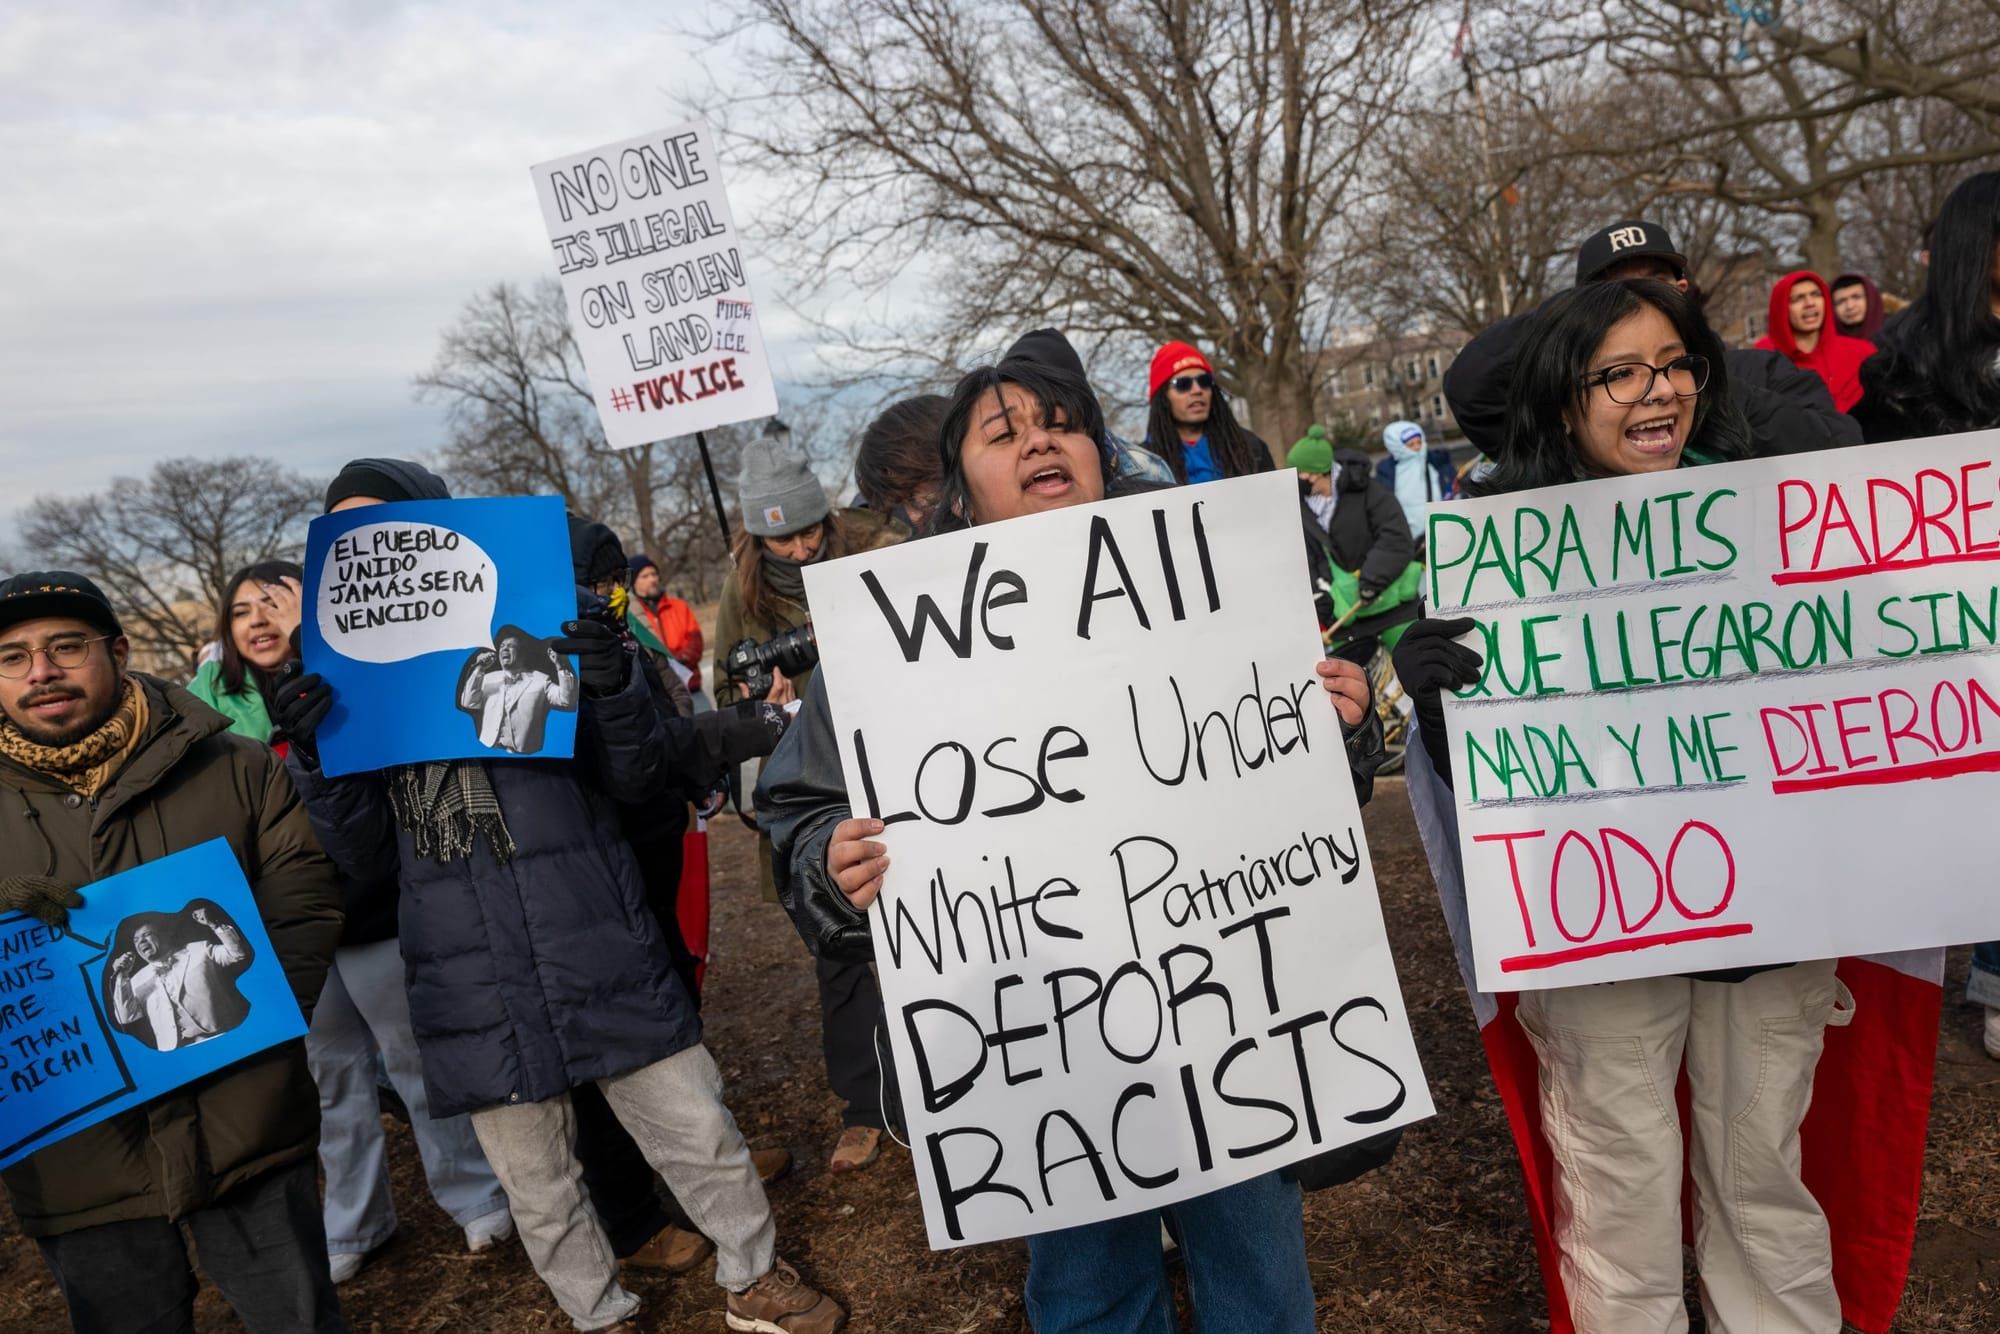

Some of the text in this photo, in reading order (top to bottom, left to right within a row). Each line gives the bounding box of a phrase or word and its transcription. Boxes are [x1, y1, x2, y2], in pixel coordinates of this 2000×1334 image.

[551, 132, 709, 222] NO ONE
[552, 200, 726, 275] IS ILLEGAL
[1608, 226, 1648, 253] RD
[581, 248, 746, 329] ON STOLEN
[610, 357, 746, 413] #FUCK ICE
[623, 314, 713, 371] LAND
[335, 528, 459, 562] EL PUEBLO
[338, 554, 418, 582] UNIDO
[1429, 461, 2000, 609] PARA MIS PADRE
[329, 563, 485, 604] JAMÁS SERÁ
[335, 598, 448, 634] VENCIDO
[860, 501, 1223, 662] We All
[1582, 590, 1855, 691] LLEGARON
[1877, 586, 1998, 658] SIN
[854, 662, 1315, 825] Lose Under
[1465, 724, 1597, 802] NADA
[1607, 724, 1646, 787] Y
[1668, 712, 1746, 787] ME
[876, 827, 1361, 975] White Patriarchy
[1473, 819, 1736, 948] TODO
[10, 1015, 82, 1059] THAN
[902, 907, 1291, 1113] DEPORT
[927, 996, 1406, 1240] RACISTS
